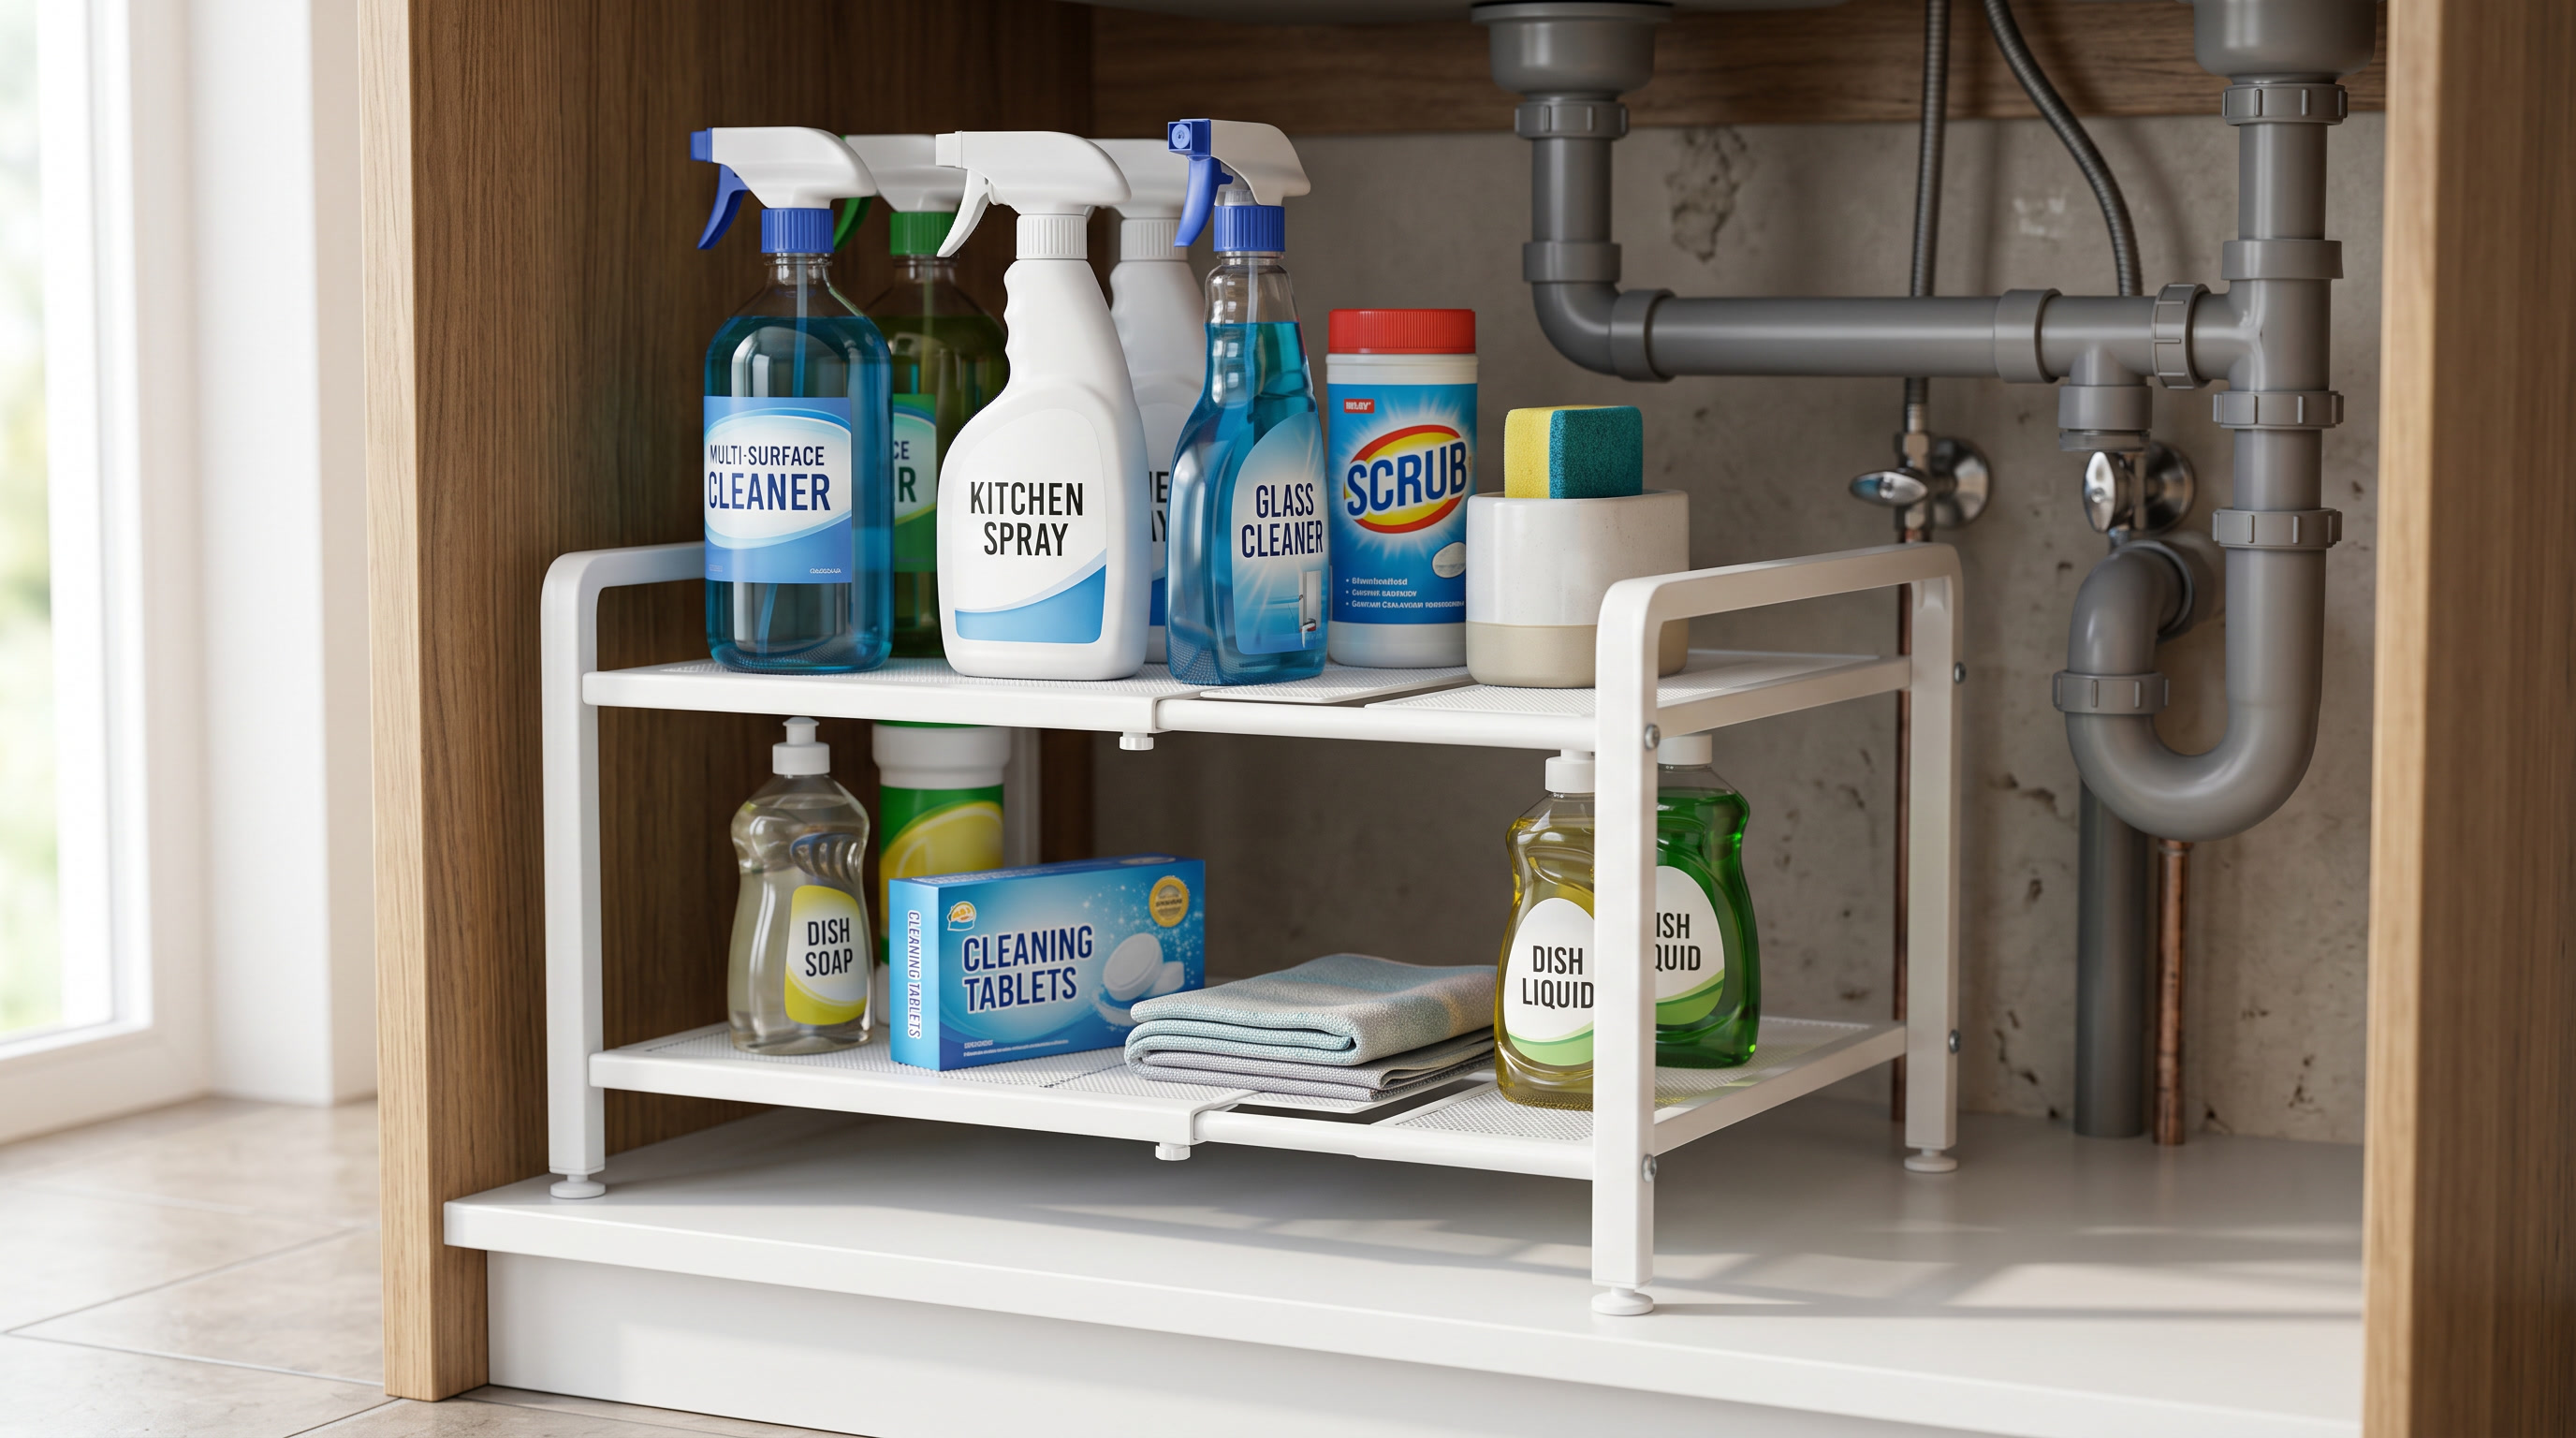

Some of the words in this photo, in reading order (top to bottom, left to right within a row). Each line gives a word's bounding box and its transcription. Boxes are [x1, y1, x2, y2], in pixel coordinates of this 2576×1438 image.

[710, 445, 825, 466] MULTI-SURFACE
[709, 471, 831, 511] CLEANER
[1347, 441, 1467, 516] SCRUB
[971, 481, 1083, 517] KITCHEN
[1255, 482, 1314, 519] GLASS
[984, 521, 1069, 557] SPRAY
[1241, 520, 1324, 559] CLEANER
[807, 917, 851, 946] DISH
[1656, 912, 1690, 939] ISH
[805, 947, 854, 977] SOAP
[908, 911, 920, 978] CLEANING
[963, 925, 1093, 972] CLEANING
[1532, 945, 1584, 976] DISH
[1655, 943, 1701, 973] QUID
[964, 967, 1077, 1013] TABLETS
[1522, 977, 1594, 1010] LIQUID
[908, 983, 921, 1038] TABLETS
